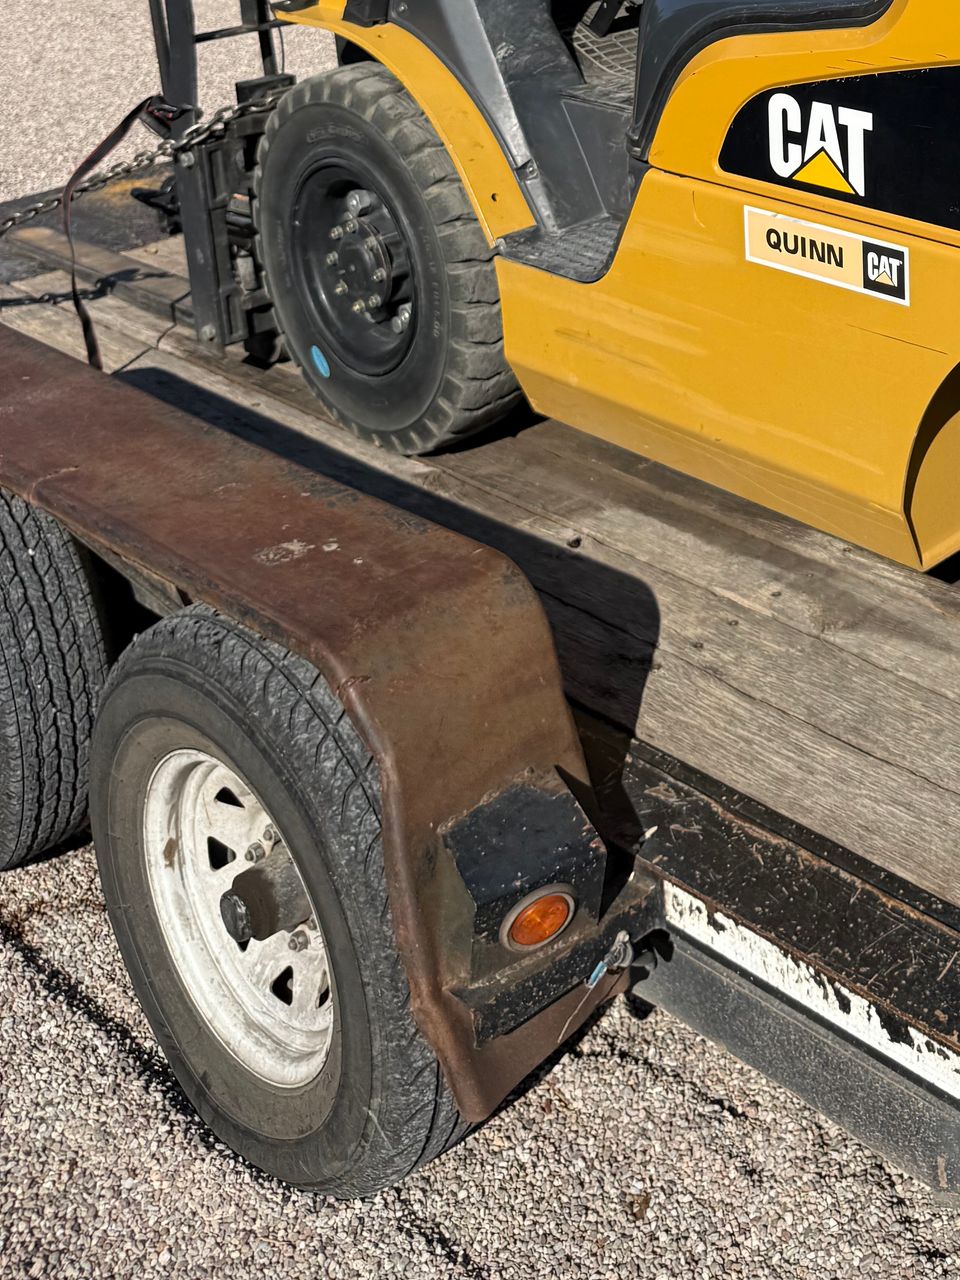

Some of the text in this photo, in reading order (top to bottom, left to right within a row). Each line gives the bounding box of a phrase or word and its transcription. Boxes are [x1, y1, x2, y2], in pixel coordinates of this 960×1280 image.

[768, 92, 873, 197] CAT
[766, 228, 901, 287] QUINN CAT
